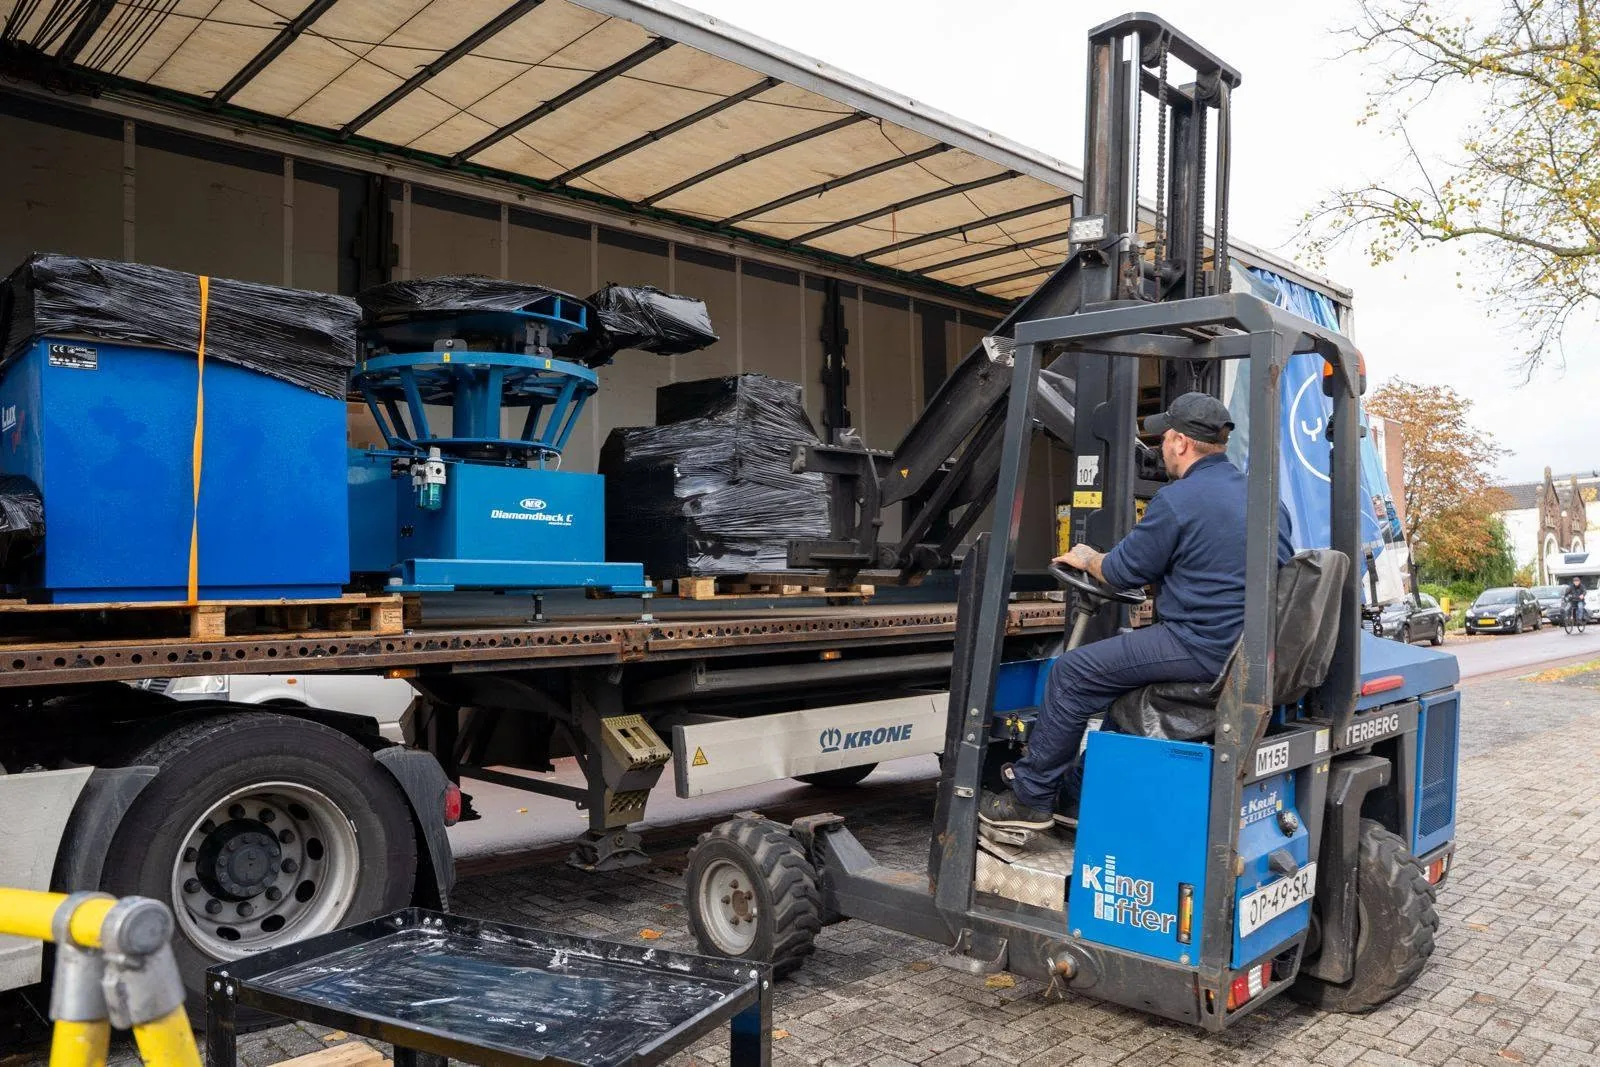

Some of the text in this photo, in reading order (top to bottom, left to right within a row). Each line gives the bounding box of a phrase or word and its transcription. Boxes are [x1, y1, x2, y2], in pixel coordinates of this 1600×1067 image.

[1080, 468, 1093, 482] 101
[491, 510, 574, 522] Diamondback C
[843, 724, 913, 749] KRONE
[1258, 747, 1288, 772] M155
[1082, 855, 1154, 906] King
